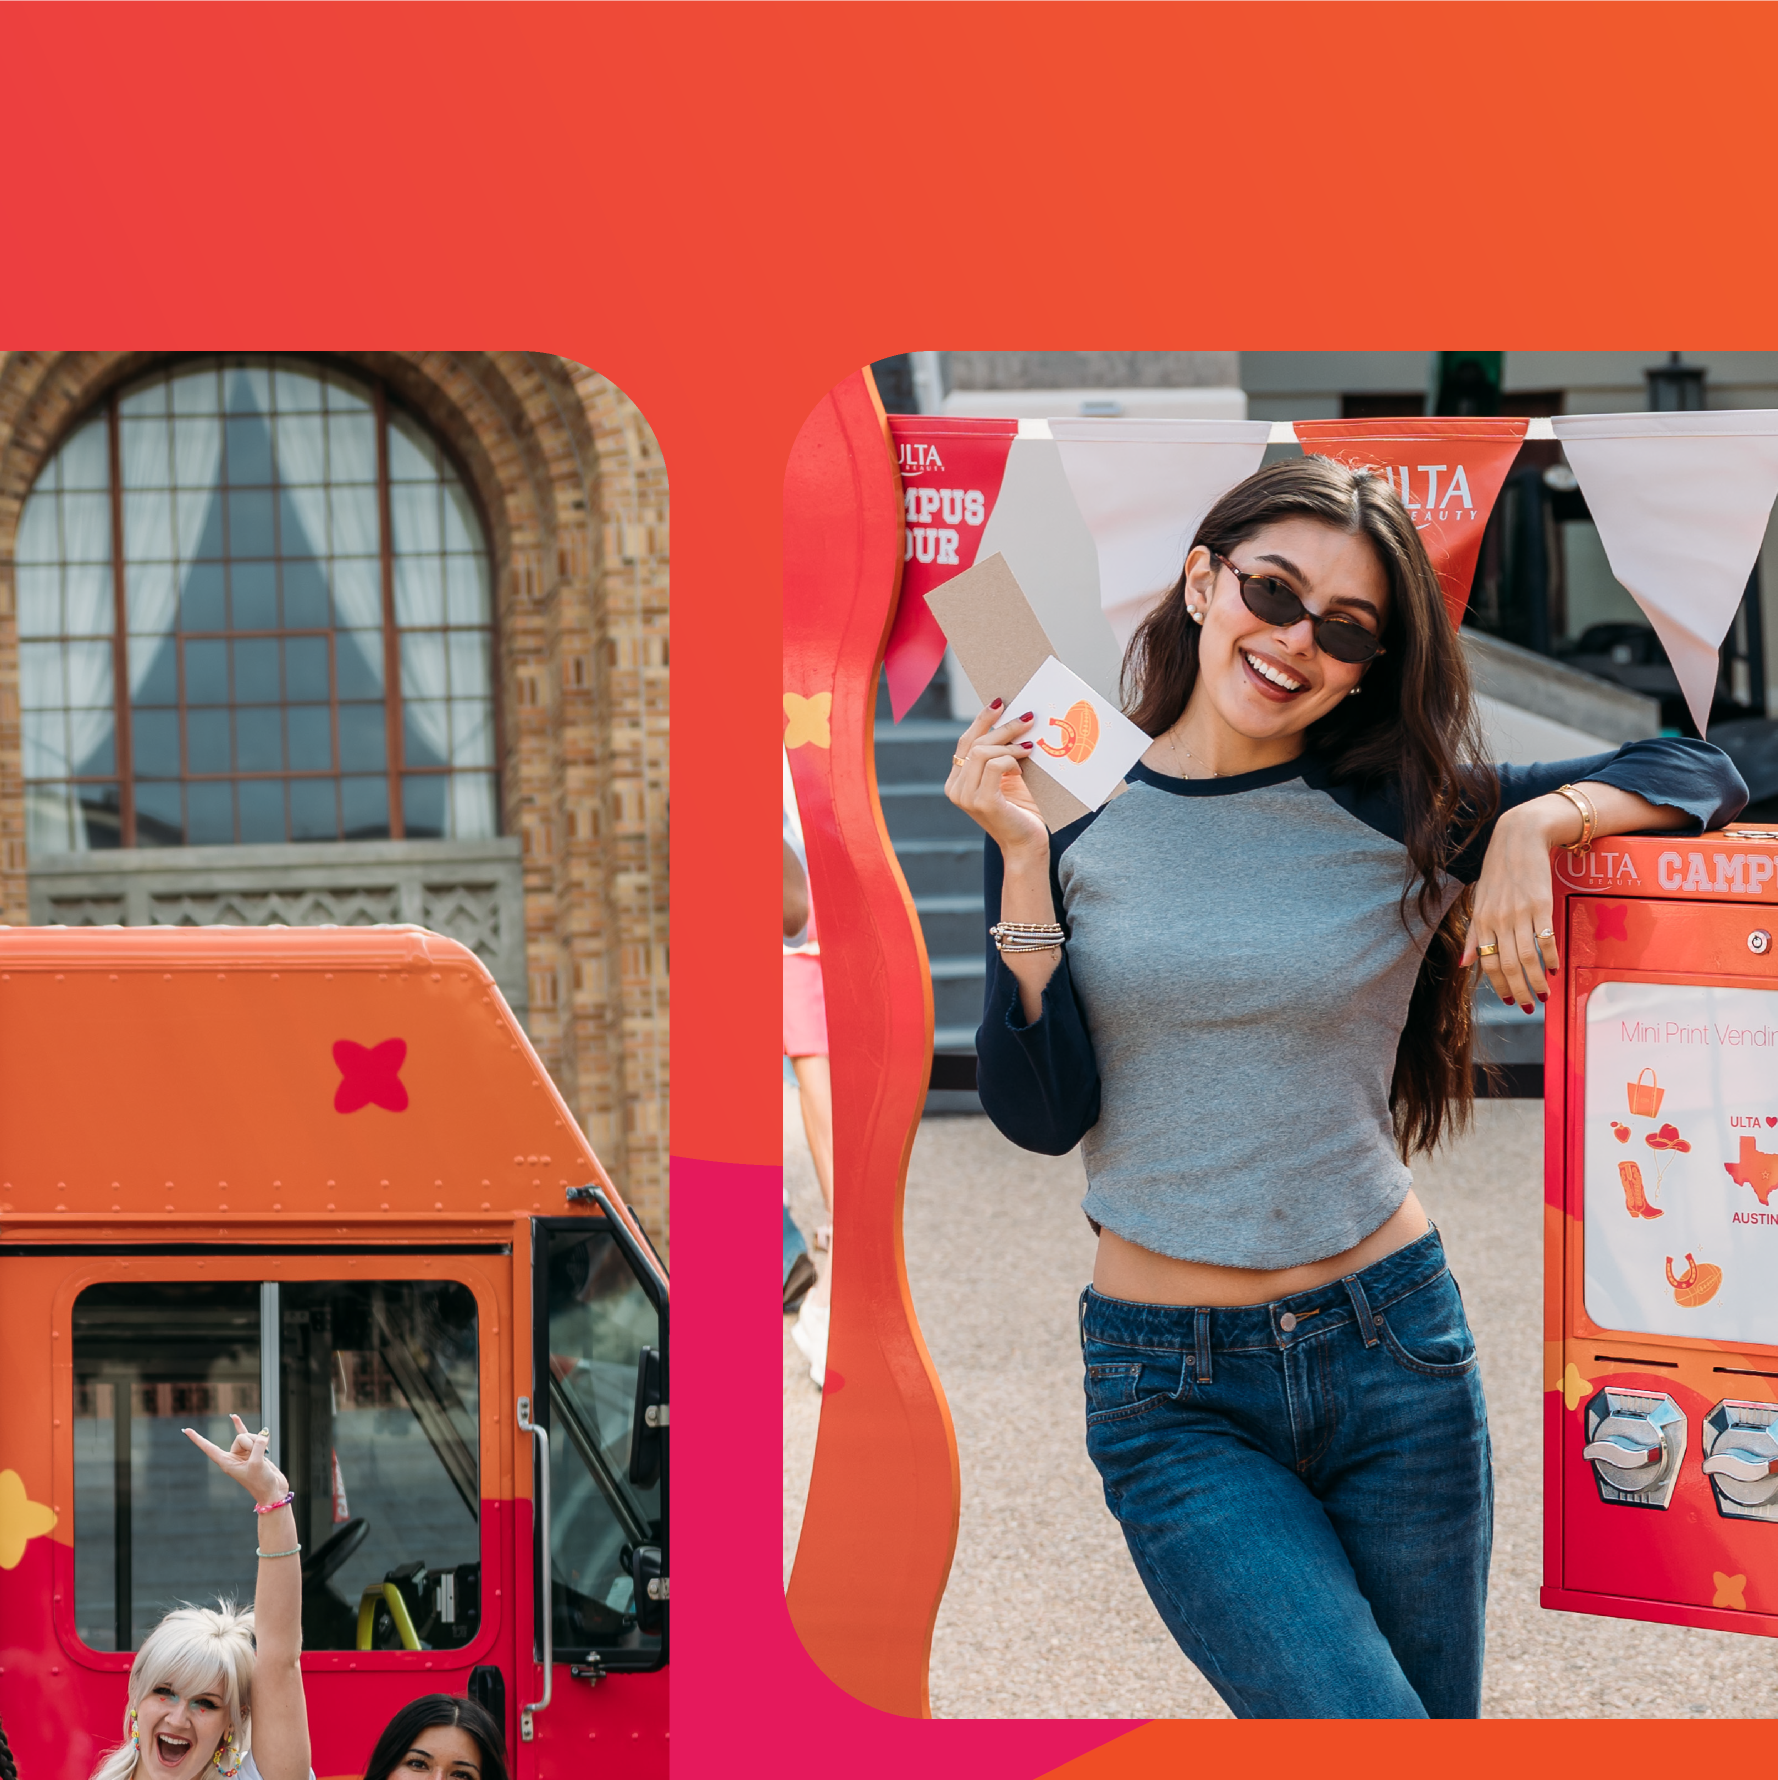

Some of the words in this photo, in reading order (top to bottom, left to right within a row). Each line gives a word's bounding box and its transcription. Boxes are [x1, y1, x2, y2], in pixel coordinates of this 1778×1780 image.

[1386, 464, 1473, 510] LTA
[904, 486, 985, 527] MPUS
[1410, 510, 1478, 521] EAUTY
[905, 527, 960, 566] UR
[1566, 850, 1638, 880] ULTA
[1588, 878, 1642, 887] BEAUTY
[1620, 1019, 1661, 1045] Mini
[1665, 1023, 1710, 1047] Print
[1729, 1115, 1762, 1131] ULTA
